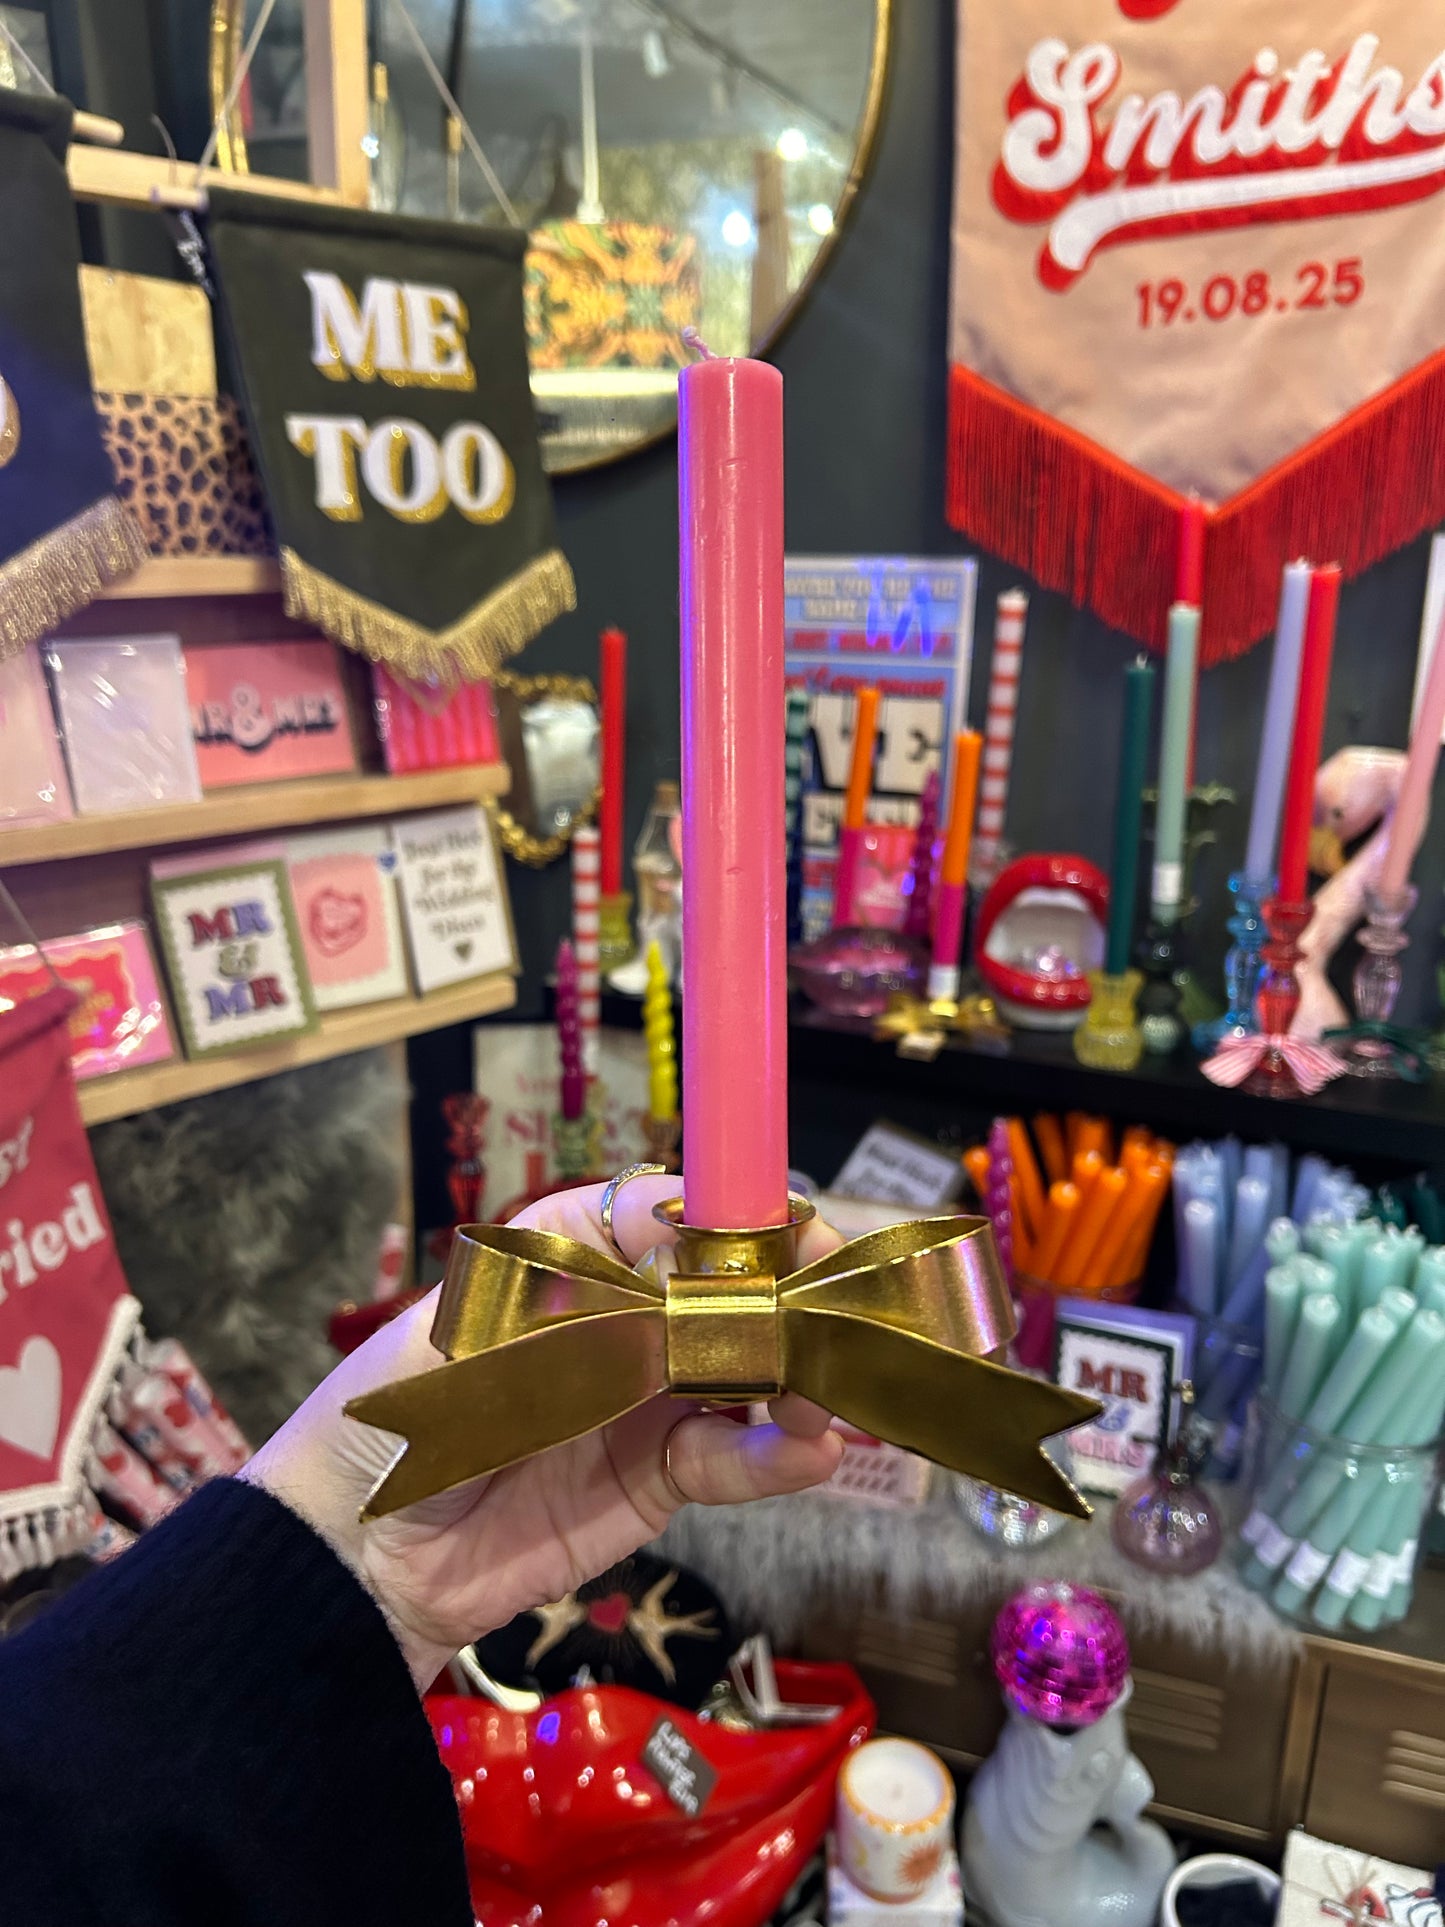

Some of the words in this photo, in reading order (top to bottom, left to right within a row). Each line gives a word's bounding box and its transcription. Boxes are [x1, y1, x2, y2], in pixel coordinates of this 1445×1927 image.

[1136, 257, 1366, 328] 19.08.25
[303, 270, 477, 392] ME
[286, 412, 515, 524] TOO
[186, 901, 273, 947] MR
[204, 975, 286, 1022] MR
[1075, 1357, 1149, 1403] MR
